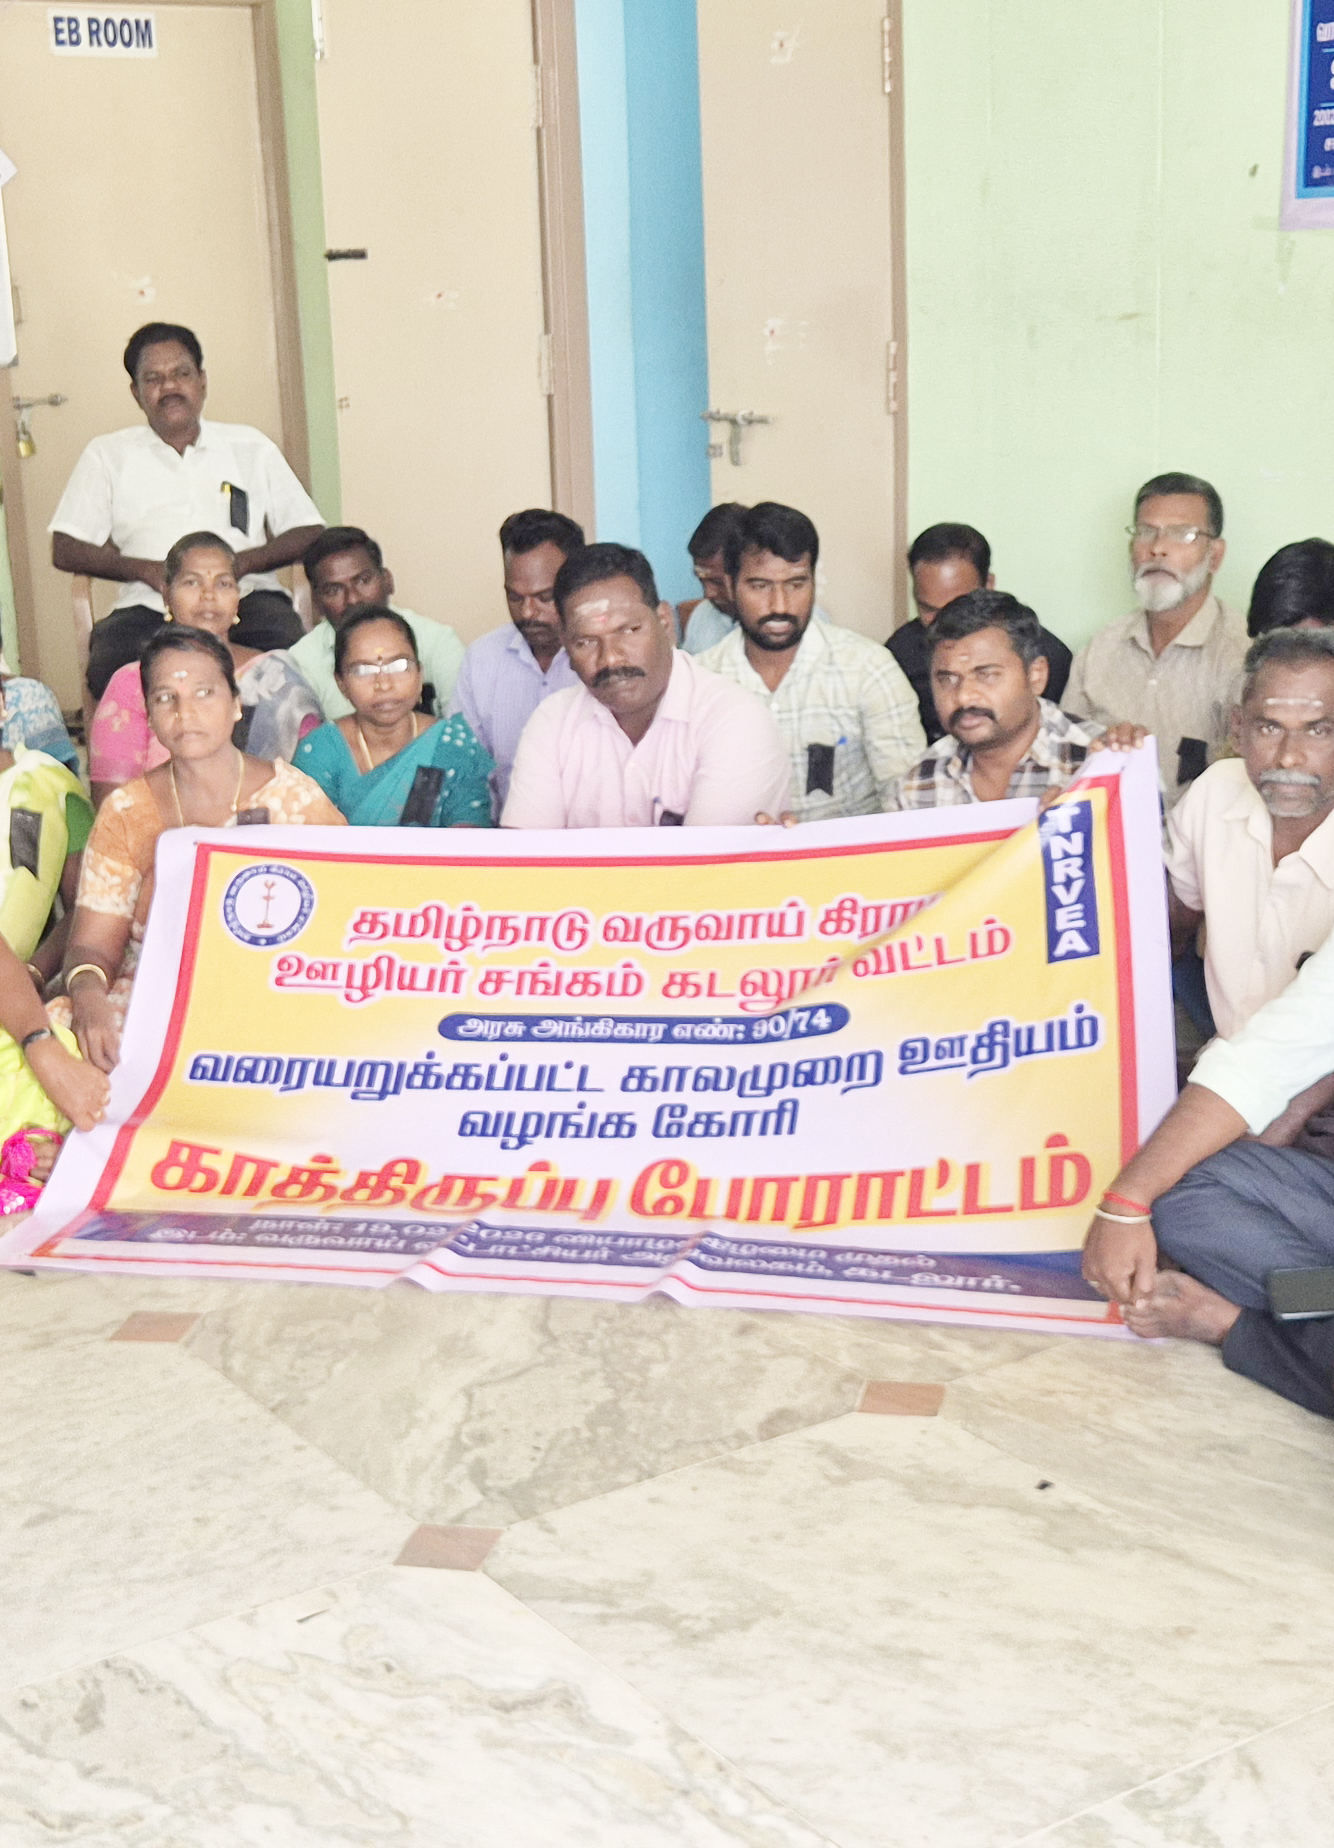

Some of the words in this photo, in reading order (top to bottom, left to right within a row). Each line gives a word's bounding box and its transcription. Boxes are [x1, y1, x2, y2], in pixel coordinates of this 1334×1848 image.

[53, 16, 82, 47] EB
[87, 17, 153, 49] ROOM
[1044, 803, 1092, 958] TNRVEA
[348, 905, 590, 952] தமிழ்நாடு
[602, 900, 805, 951] வருவாய்
[274, 954, 466, 1003] ஊழியர்
[478, 961, 646, 998] சங்கம்
[662, 956, 841, 1013] கடலூர்
[852, 918, 1012, 978] வட்டம்
[188, 1051, 604, 1101] வரையறுக்கப்பட்ட
[619, 1049, 885, 1099] காலமுறை
[898, 1002, 1099, 1079] ஊதியம்
[457, 1018, 527, 1041] அரசு
[672, 1017, 747, 1040] எண்:
[752, 997, 833, 1040] 90/74
[457, 1100, 638, 1151] வழங்க
[651, 1097, 800, 1139] கோரி
[149, 1138, 616, 1220] காத்திருப்பு
[629, 1131, 1093, 1230] போராட்டம்
